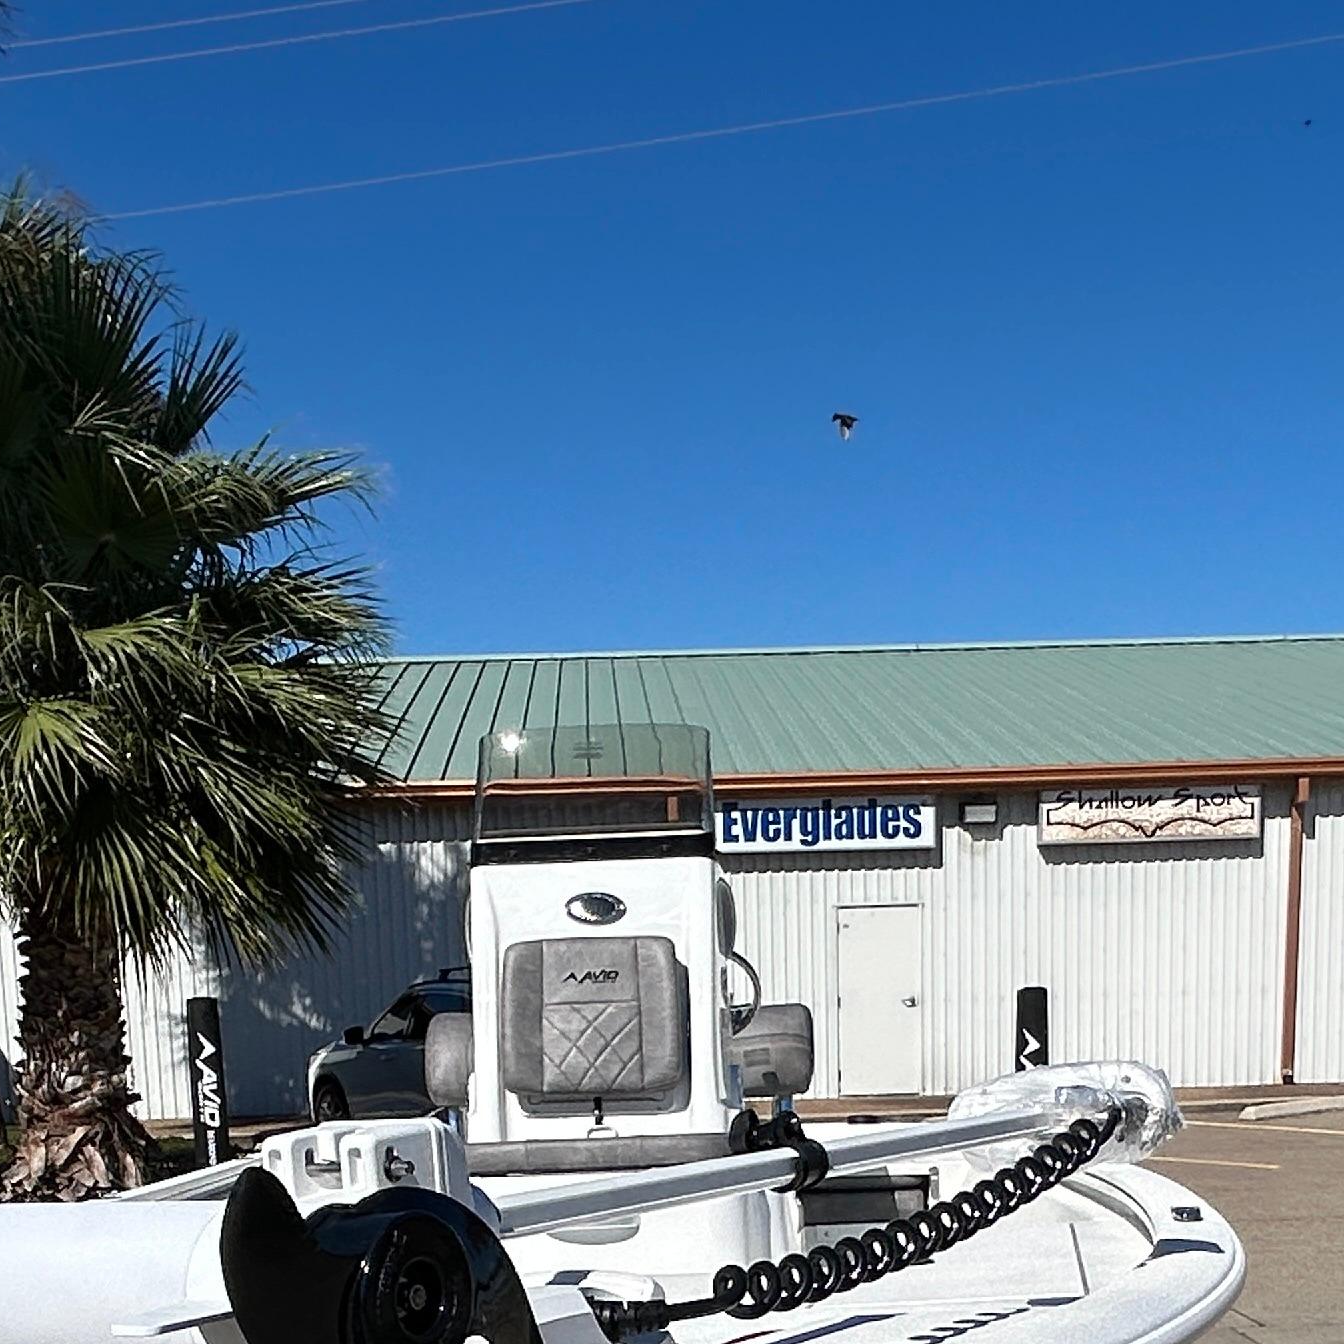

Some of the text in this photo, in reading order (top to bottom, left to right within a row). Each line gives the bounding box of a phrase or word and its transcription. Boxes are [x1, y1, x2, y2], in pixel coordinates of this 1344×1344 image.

[1057, 784, 1250, 812] Shallow Sport
[722, 799, 922, 846] Everglades
[195, 1058, 222, 1128] AVID
